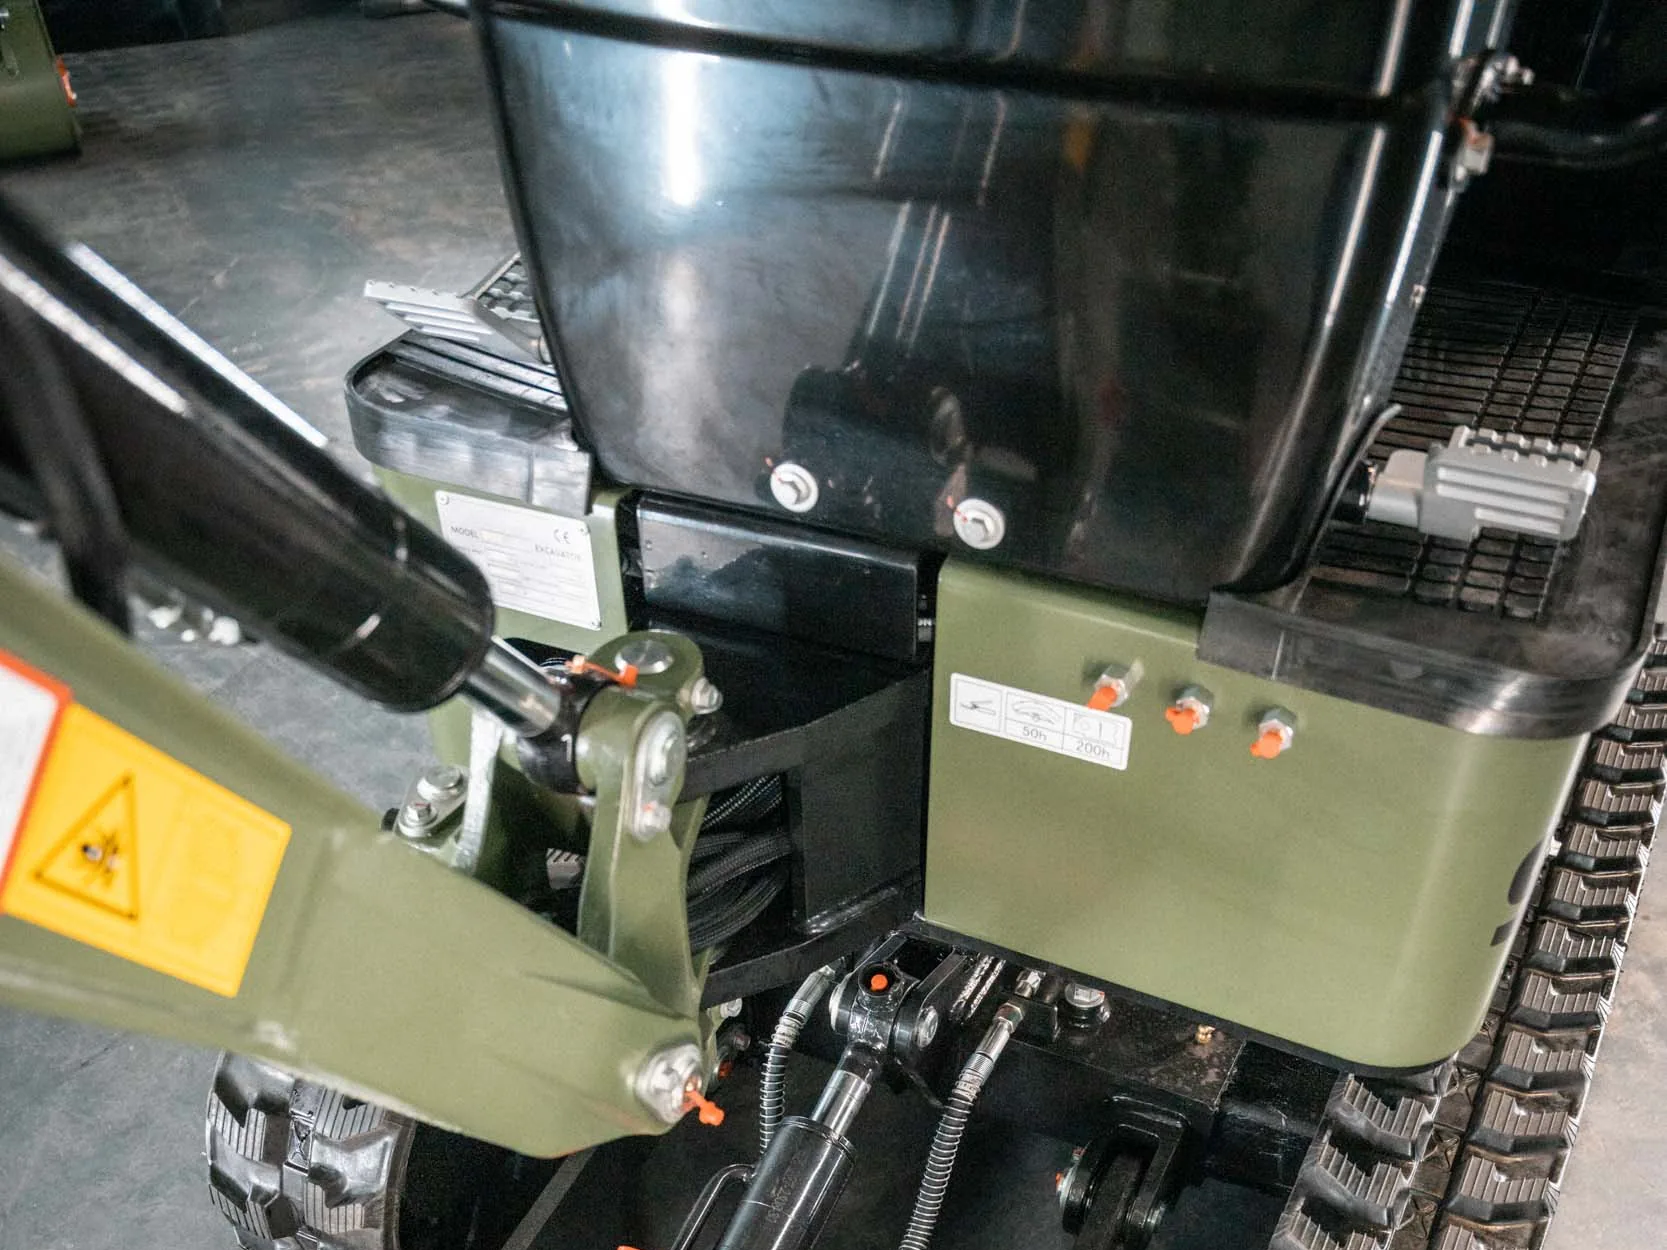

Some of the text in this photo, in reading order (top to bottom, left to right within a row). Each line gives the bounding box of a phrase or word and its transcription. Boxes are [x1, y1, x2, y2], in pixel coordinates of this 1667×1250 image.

[450, 525, 479, 539] MODEL
[1022, 725, 1047, 741] 50h
[1076, 740, 1110, 760] 200h
